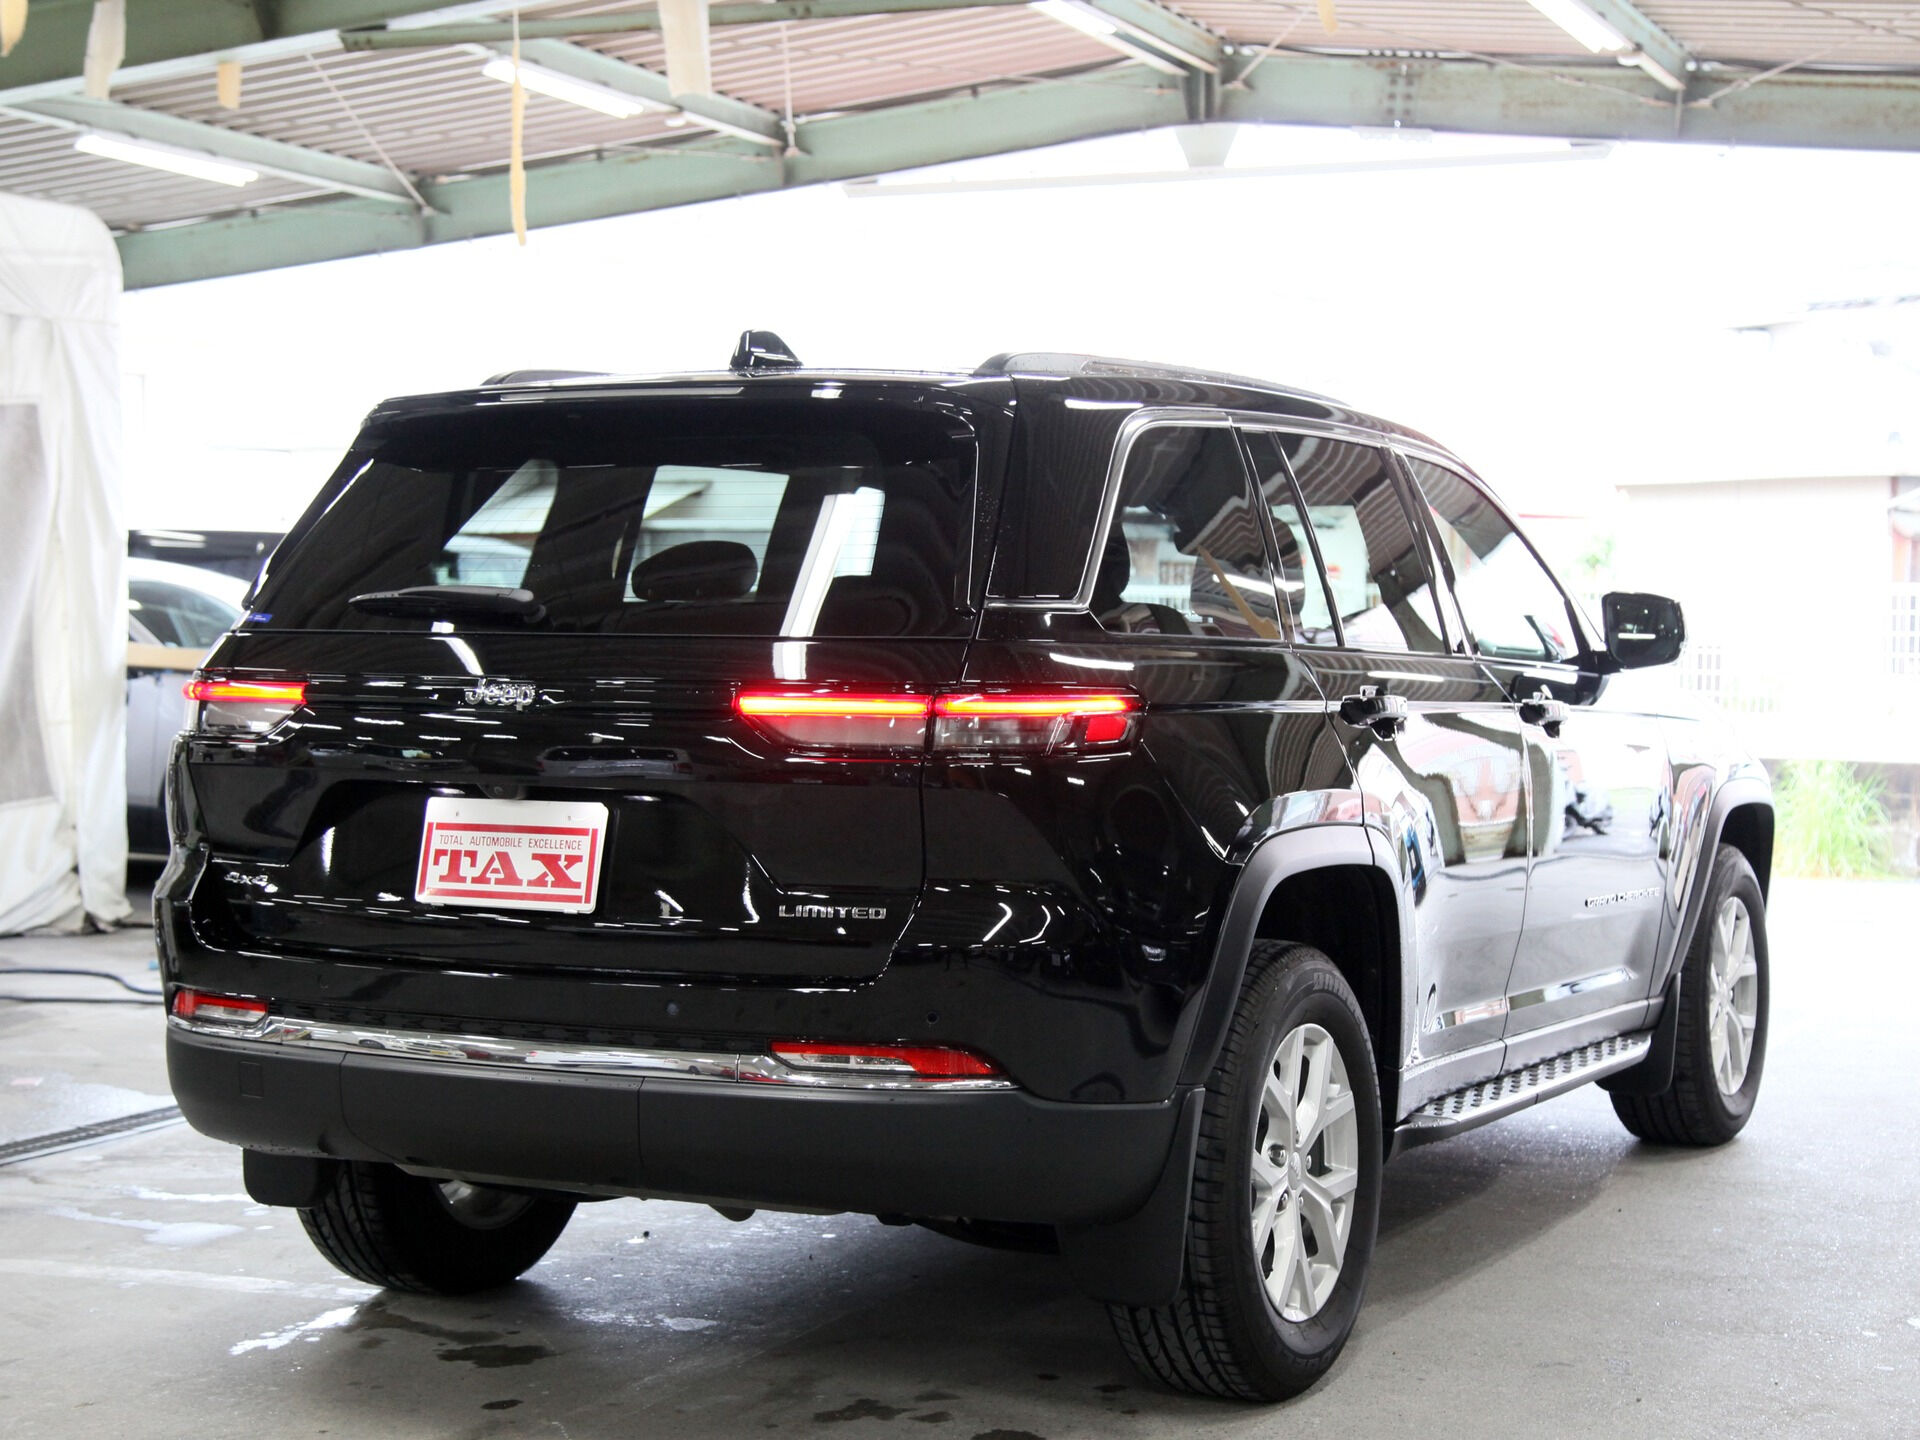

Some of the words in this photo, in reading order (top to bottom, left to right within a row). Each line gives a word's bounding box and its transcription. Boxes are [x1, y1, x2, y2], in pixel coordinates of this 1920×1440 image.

[464, 678, 536, 711] Jeep
[440, 834, 464, 846] TOTAL
[470, 836, 523, 848] AUTOMOBILE
[528, 838, 583, 850] EXCELLENCE
[433, 848, 583, 889] TAX
[779, 904, 887, 919] LIMITED
